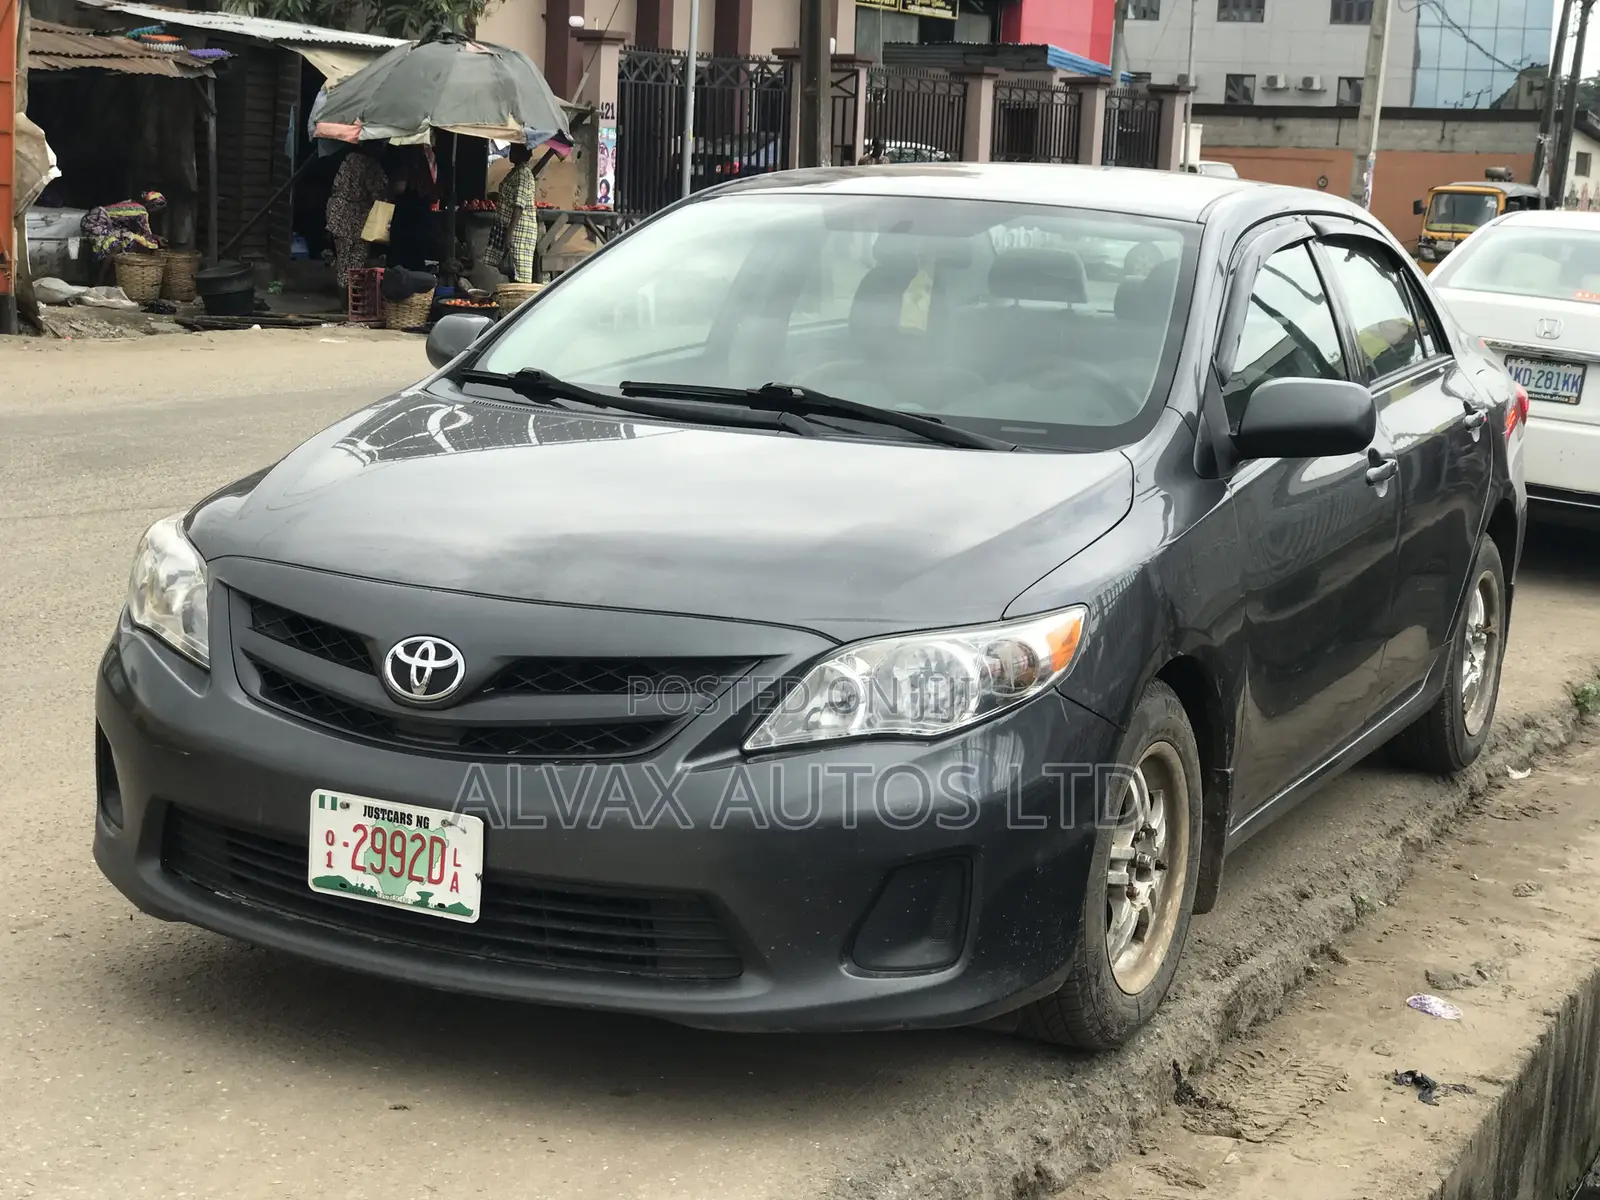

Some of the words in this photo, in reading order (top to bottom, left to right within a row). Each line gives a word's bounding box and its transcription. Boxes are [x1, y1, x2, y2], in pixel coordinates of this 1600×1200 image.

[601, 102, 615, 120] 121
[1528, 393, 1568, 402] utochek.africa
[363, 805, 413, 826] JUSTCARS
[416, 816, 430, 829] NG
